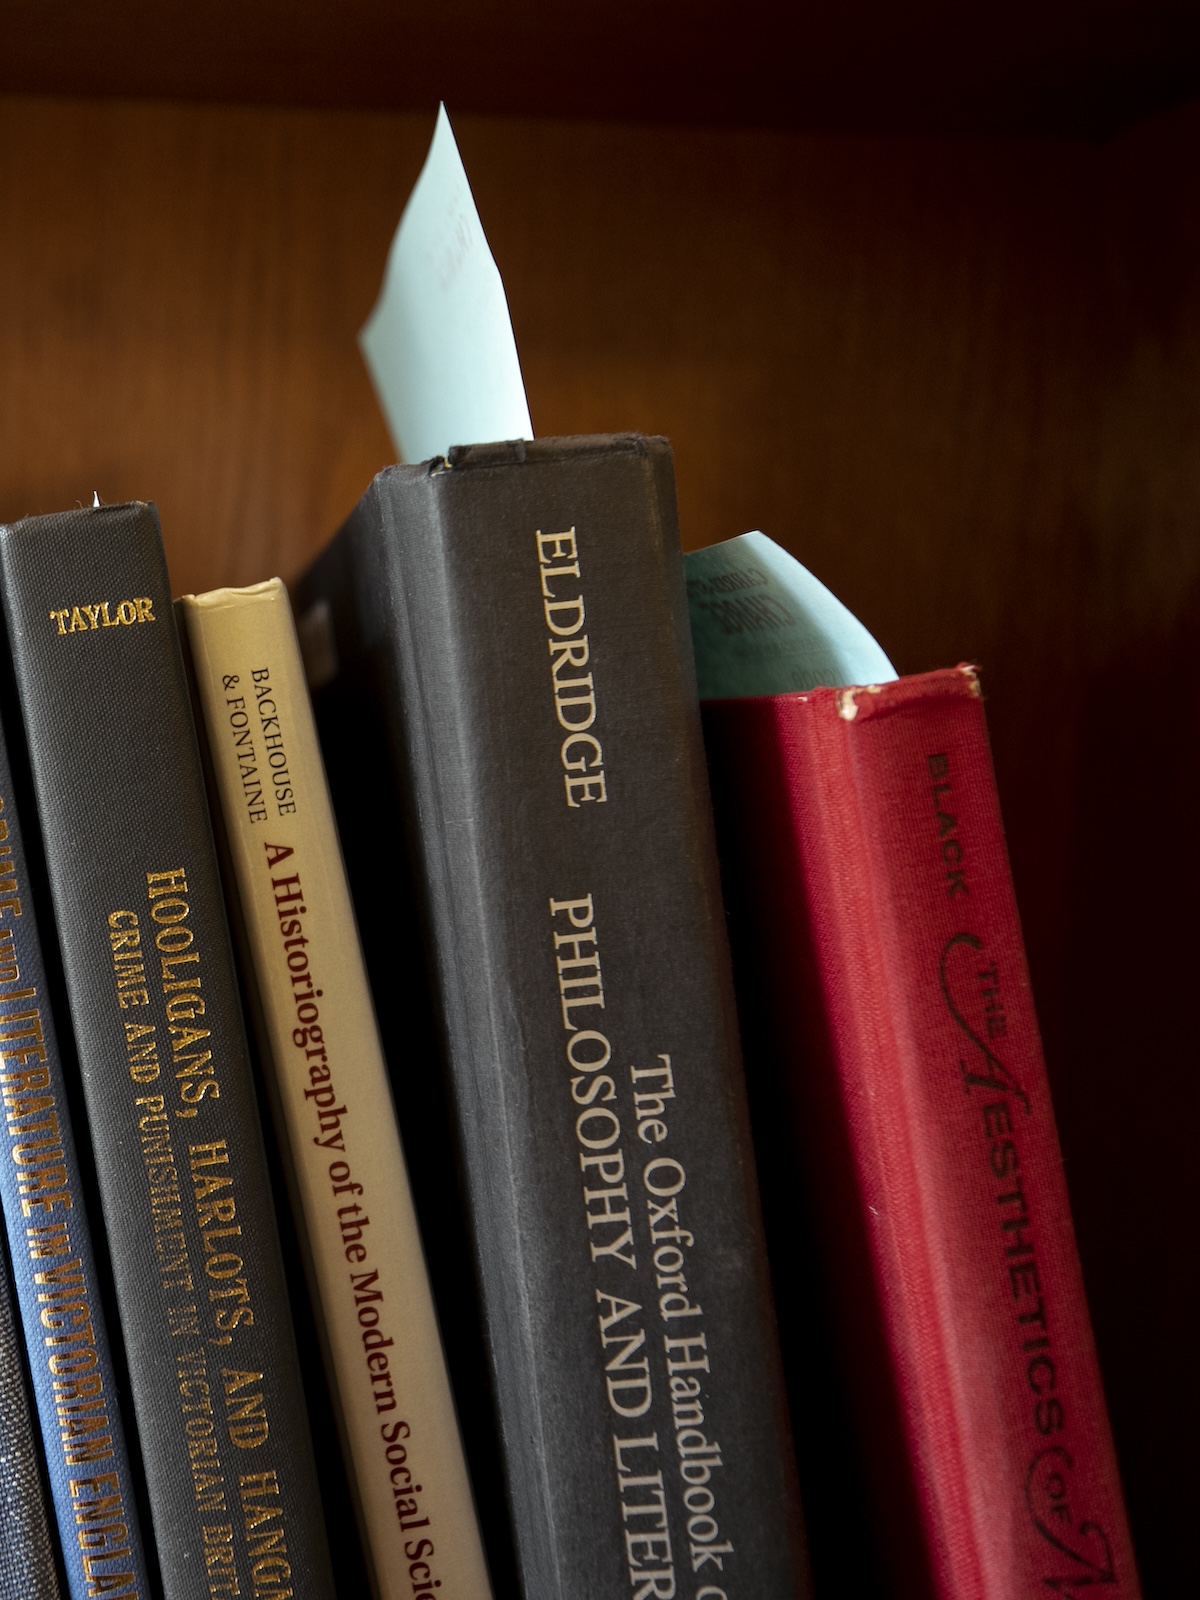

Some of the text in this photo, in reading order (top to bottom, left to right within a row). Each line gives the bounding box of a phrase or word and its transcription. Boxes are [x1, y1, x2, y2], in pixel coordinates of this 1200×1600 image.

[49, 596, 156, 635] TAYLOR
[535, 526, 608, 808] ELDRIDGE
[222, 674, 268, 824] & FONTAINE
[251, 667, 297, 816] BACKHOUSE
[264, 841, 295, 869] A
[927, 752, 970, 898] BLACK
[145, 867, 220, 1118] HOOLIGANS,
[271, 872, 348, 1152] Historiography
[976, 961, 1008, 1040] THE
[549, 893, 637, 1270] PHILOSOPHY
[595, 1288, 653, 1418] AND
[630, 1053, 676, 1145] The
[25, 1222, 72, 1260] IN
[188, 1139, 254, 1346] HARLOTS,
[328, 1160, 364, 1197] of
[337, 1203, 370, 1263] the
[643, 1157, 704, 1322] Oxford
[939, 932, 1066, 1438] AESTHETICS
[107, 910, 241, 1600] CRIME AND PUNISHMENT IN VICTORIAN BRIT
[33, 1257, 115, 1466] VICTORIAN
[220, 1367, 269, 1450] AND
[350, 1268, 398, 1415] Modern
[380, 1420, 431, 1533] Social
[664, 1332, 735, 1573] Handbook
[1046, 1472, 1073, 1525] OF
